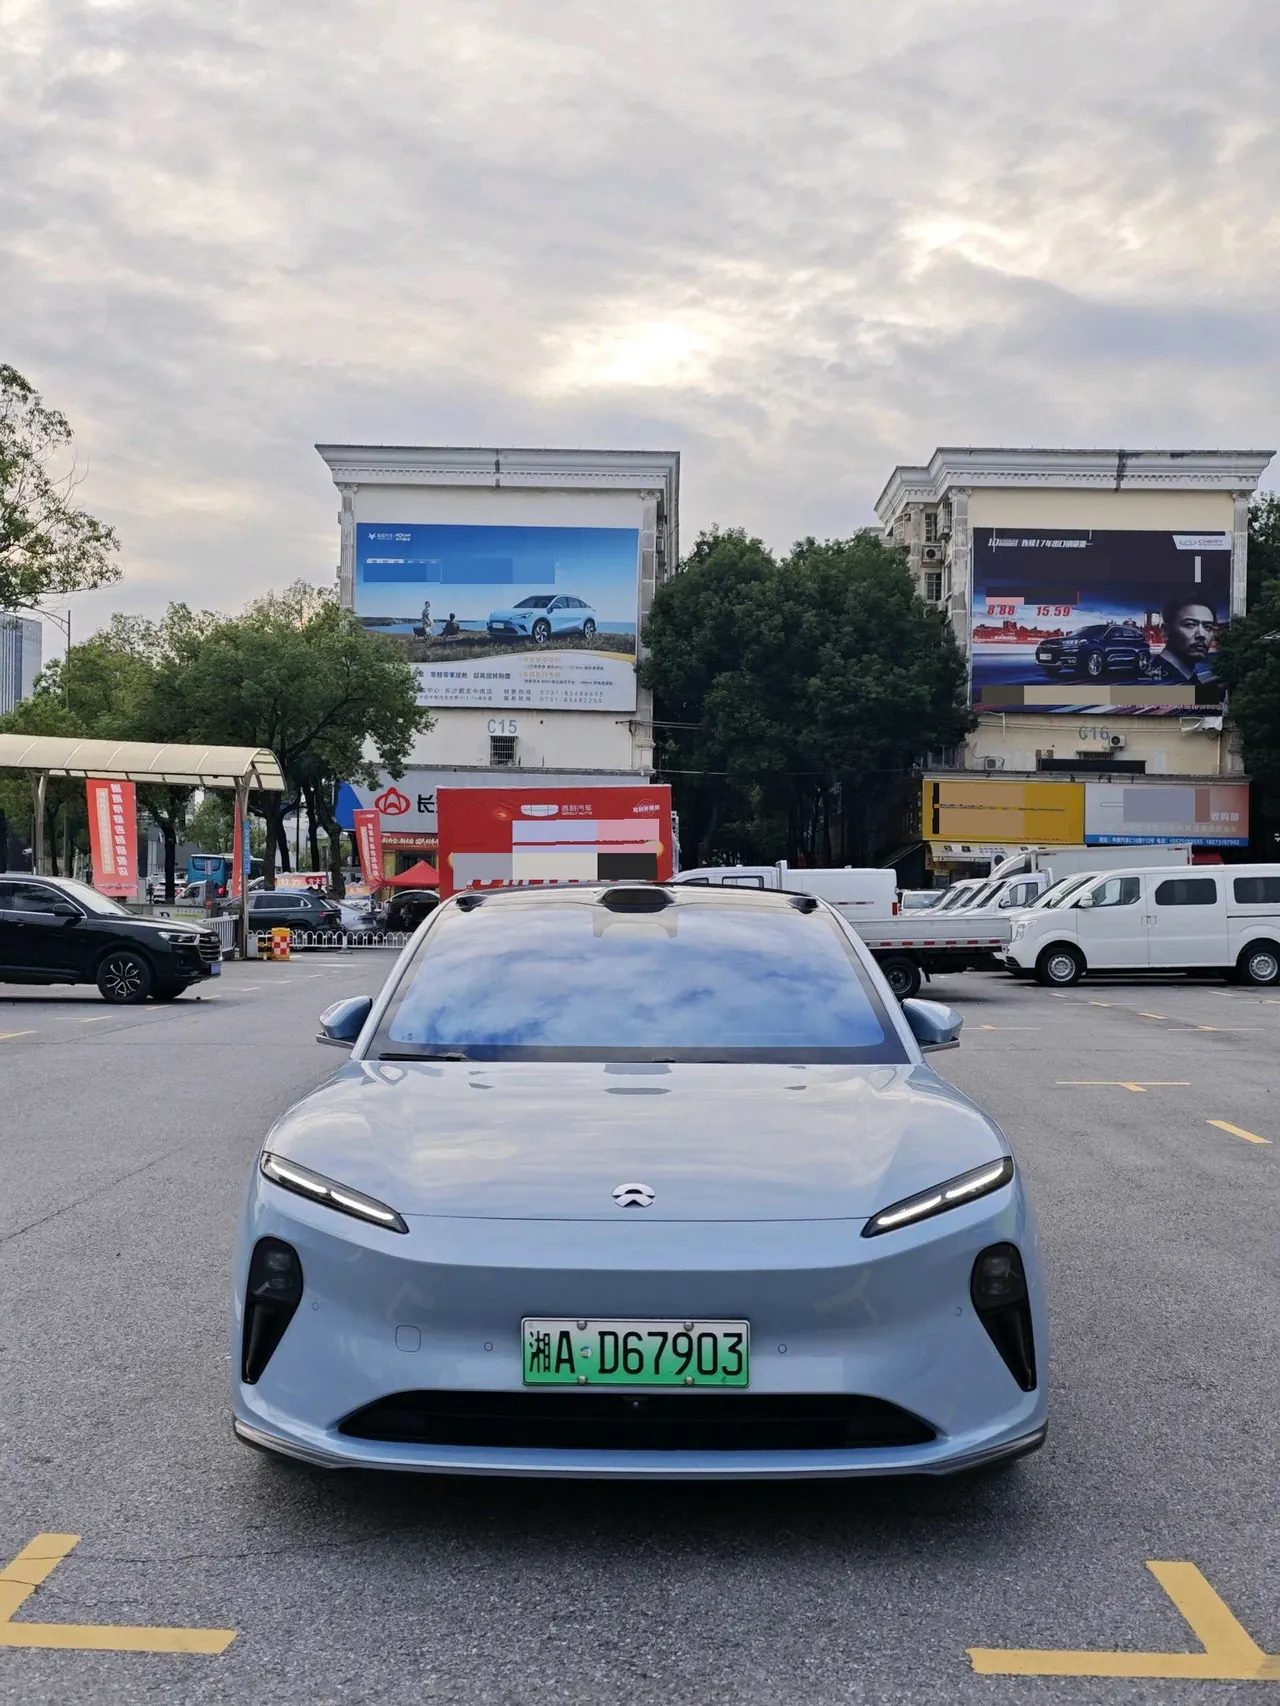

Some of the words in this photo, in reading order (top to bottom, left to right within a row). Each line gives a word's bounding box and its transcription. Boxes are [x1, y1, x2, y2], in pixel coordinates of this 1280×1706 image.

[987, 604, 1015, 616] 8.88
[1036, 606, 1071, 617] 15.59
[487, 718, 517, 734] C15
[1079, 726, 1109, 741] C16
[561, 804, 593, 812] 吉利汽车
